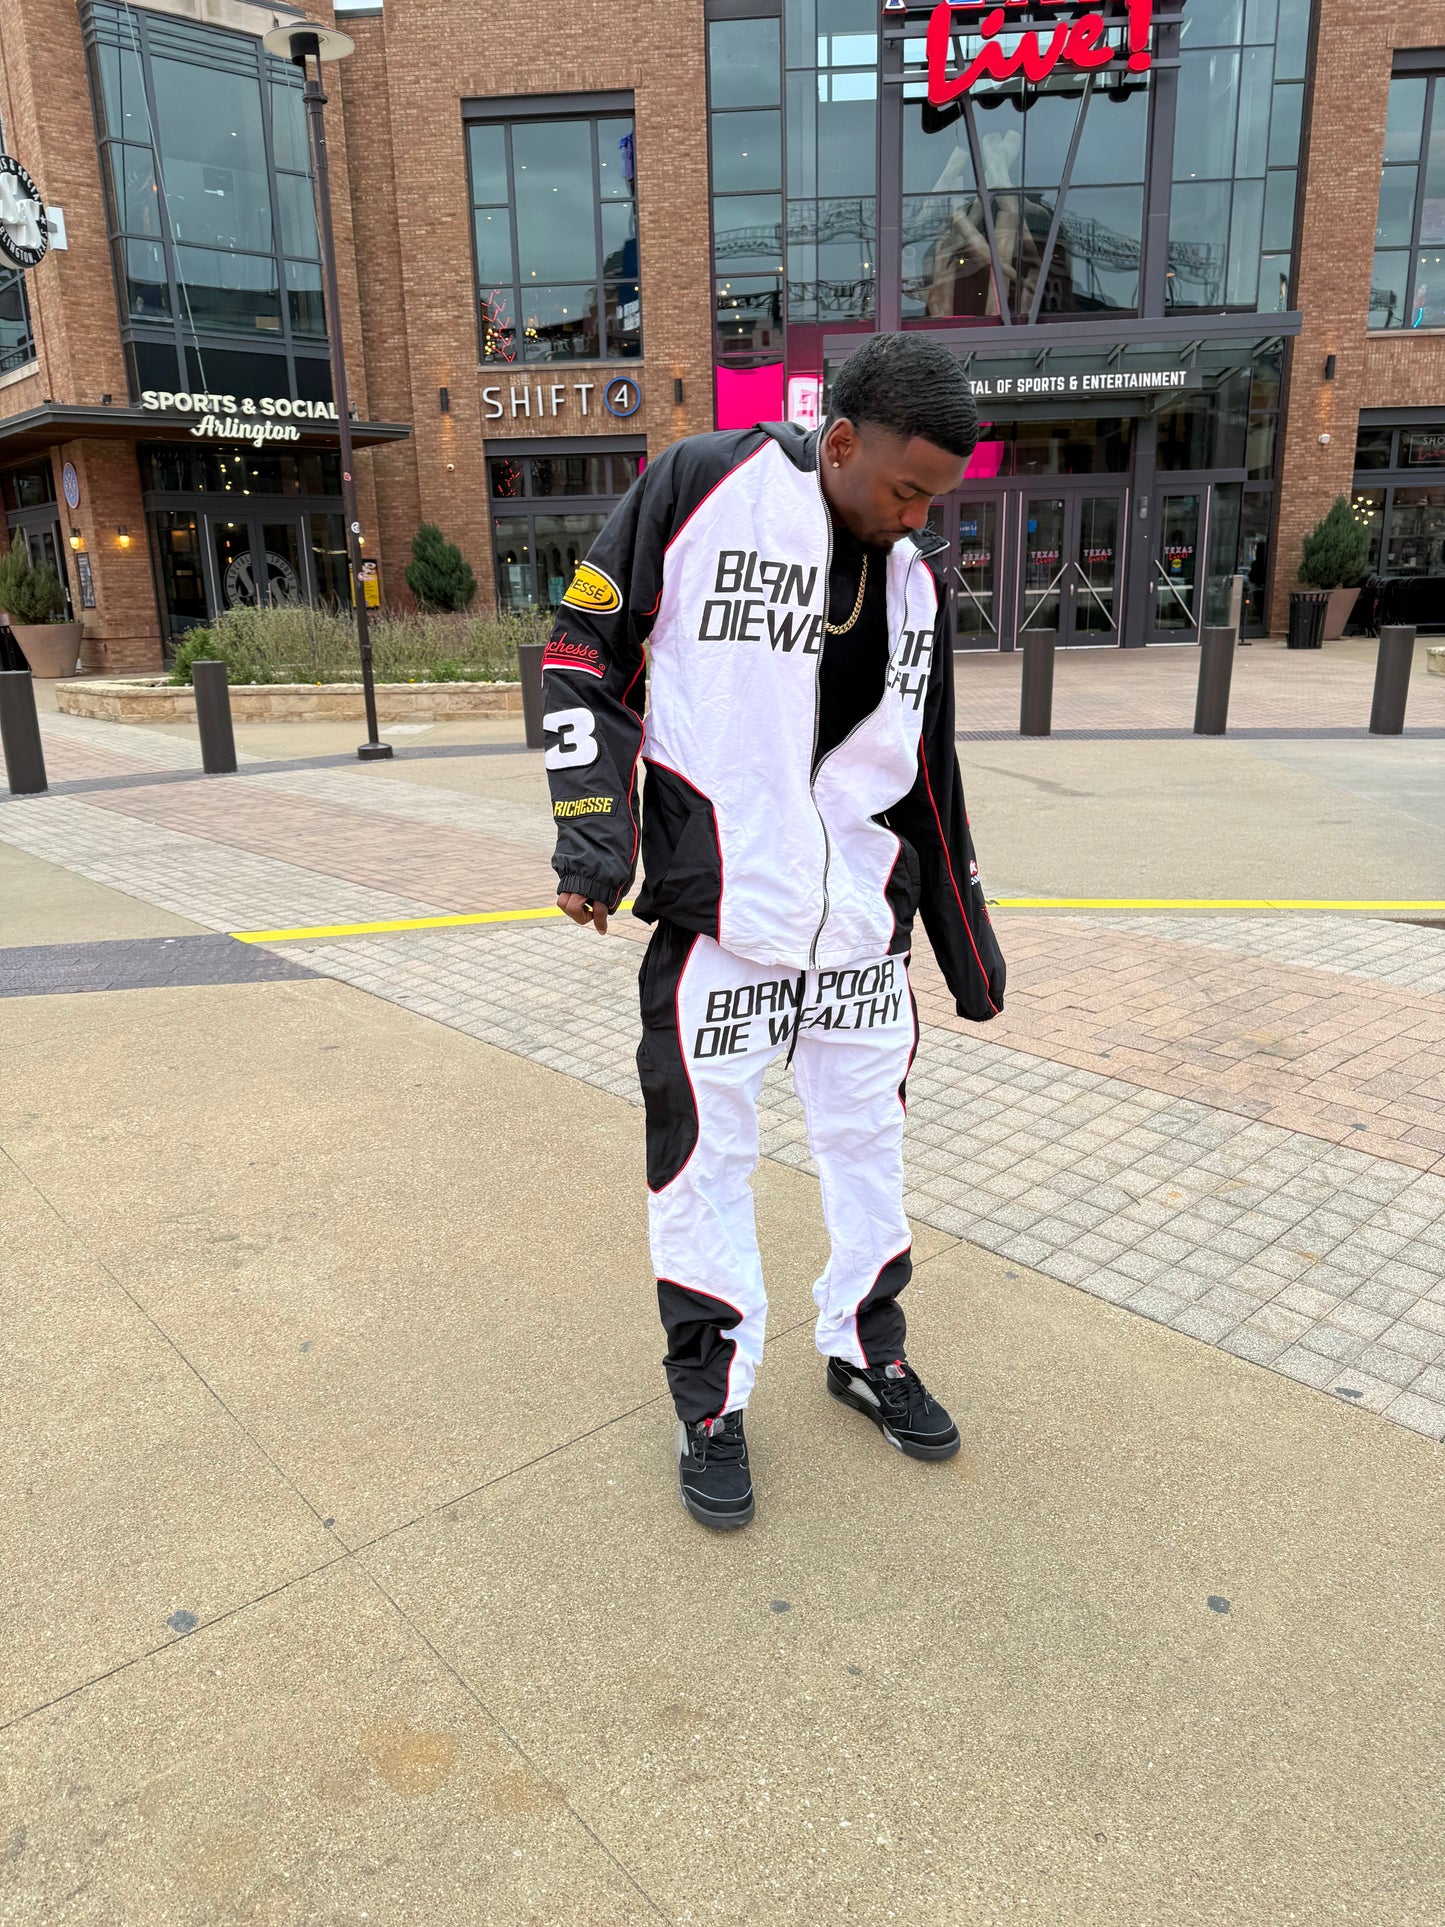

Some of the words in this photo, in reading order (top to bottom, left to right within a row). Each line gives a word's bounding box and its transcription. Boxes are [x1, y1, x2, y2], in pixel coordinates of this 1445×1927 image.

[926, 0, 1153, 107] Live!
[996, 378, 1013, 393] OF
[1017, 376, 1065, 392] SPORTS
[1069, 375, 1079, 390] &
[1082, 371, 1187, 389] ENTERTAINMENT
[142, 391, 237, 414] SPORTS
[241, 397, 257, 415] &
[259, 397, 340, 420] SOCIAL
[482, 383, 595, 418] SHIFT
[614, 384, 629, 408] 4
[190, 415, 301, 448] Arlington
[1030, 550, 1059, 559] TEXAS
[1083, 548, 1113, 557] TEXAS
[1164, 546, 1193, 555] TEXAS
[698, 600, 766, 642] DIE
[542, 707, 599, 771] 3
[553, 797, 614, 817] RICHESSE
[706, 976, 801, 1023] BORN
[816, 959, 895, 1004] POOR
[693, 1022, 752, 1059] DIE
